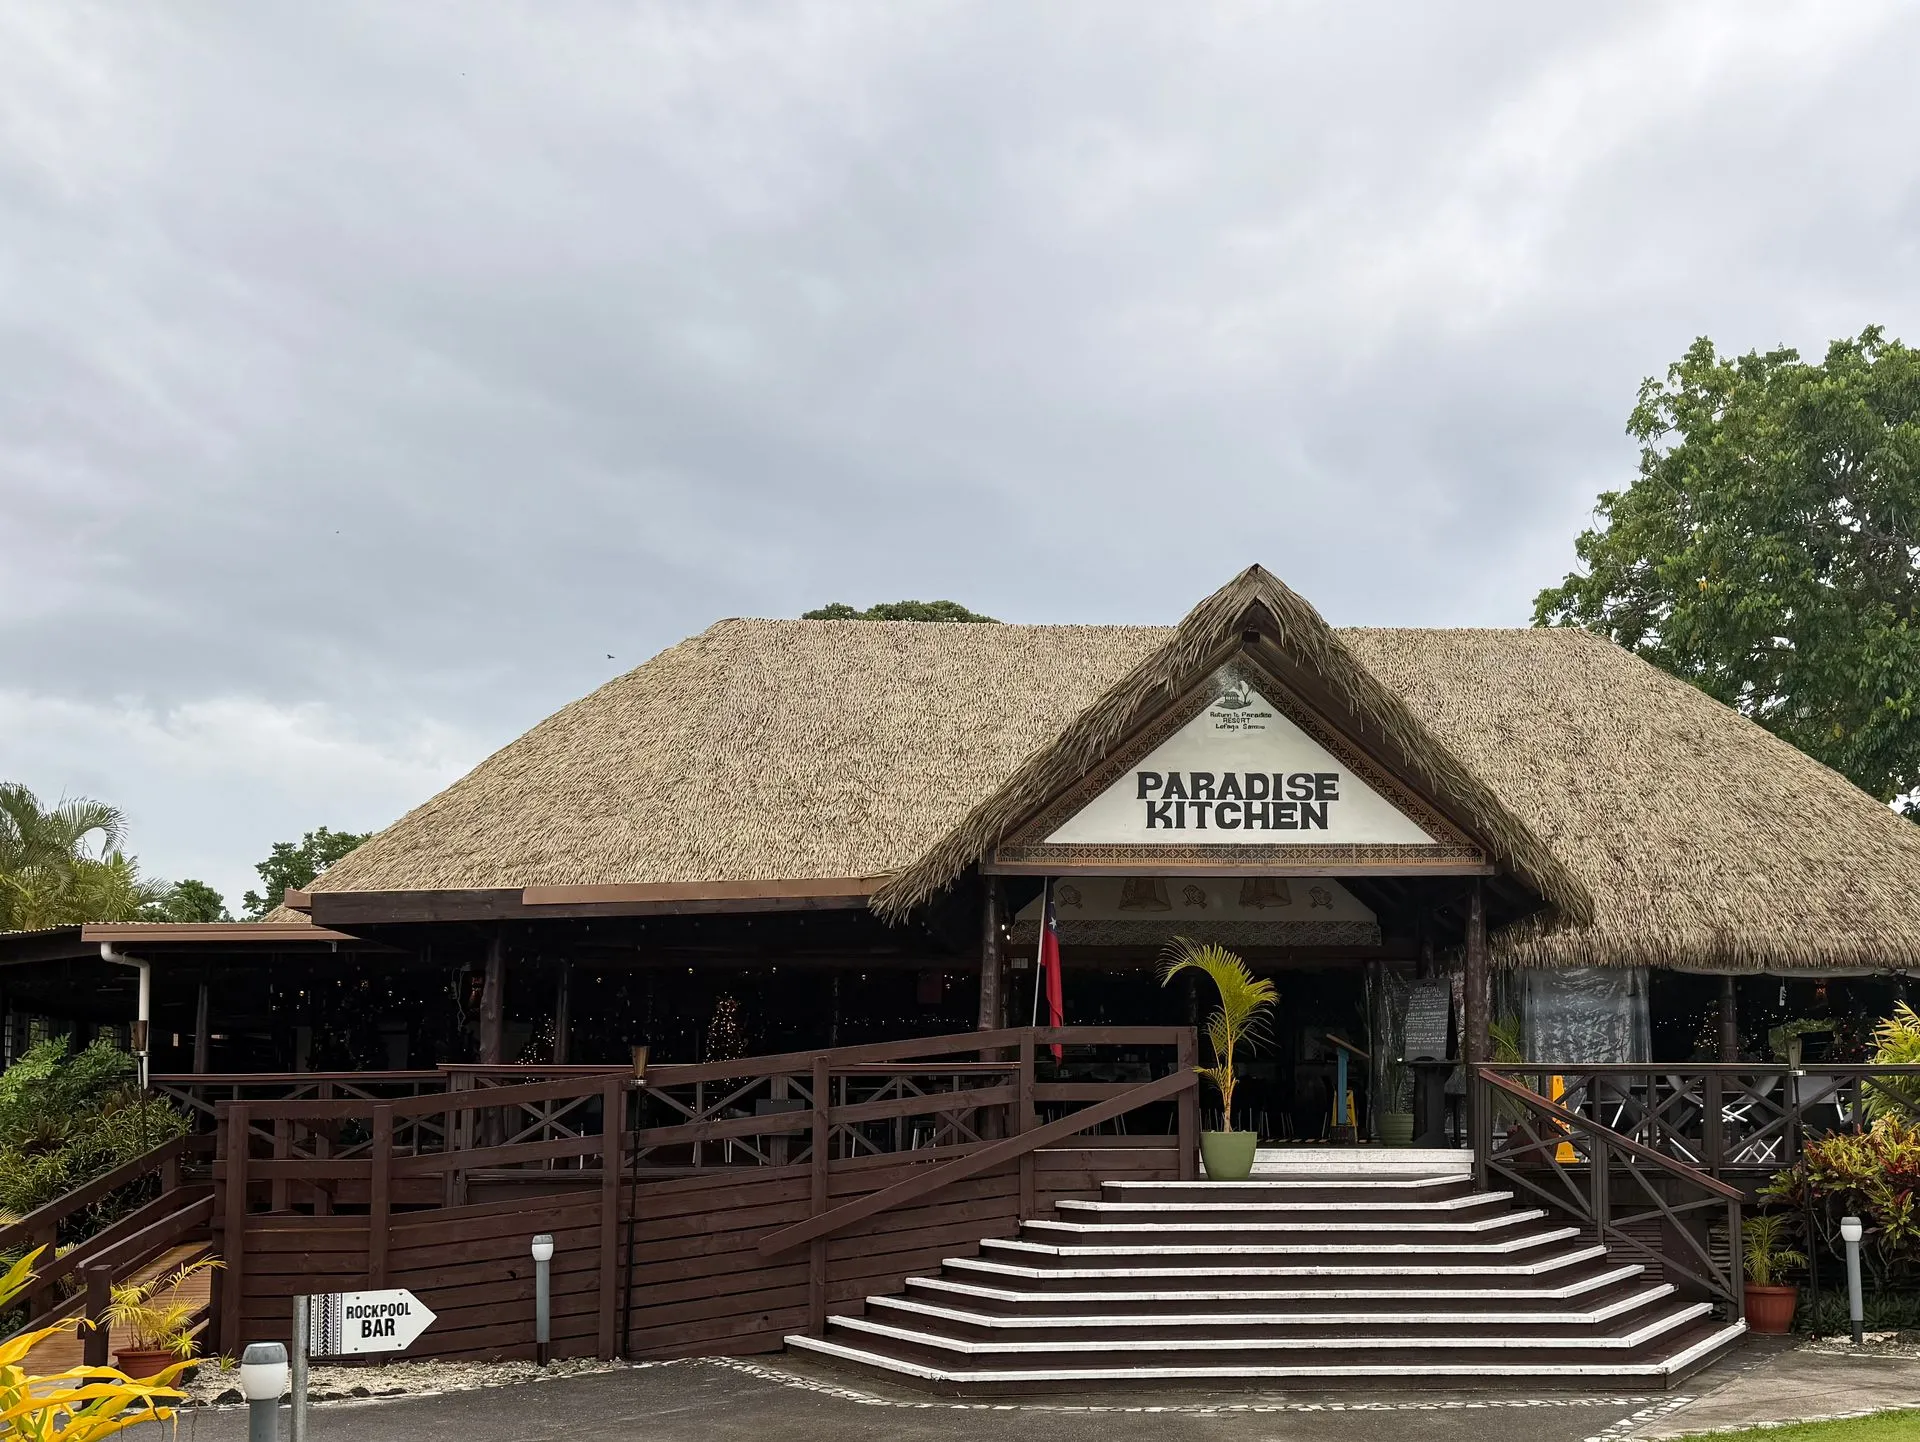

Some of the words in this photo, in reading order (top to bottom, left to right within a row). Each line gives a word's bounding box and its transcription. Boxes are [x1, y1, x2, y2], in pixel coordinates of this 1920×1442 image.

[1215, 723, 1239, 732] Lefaga
[1136, 771, 1339, 801] PARADISE
[1145, 801, 1329, 830] KITCHEN
[346, 1302, 411, 1320] ROCKPOOL
[361, 1318, 396, 1338] BAR
